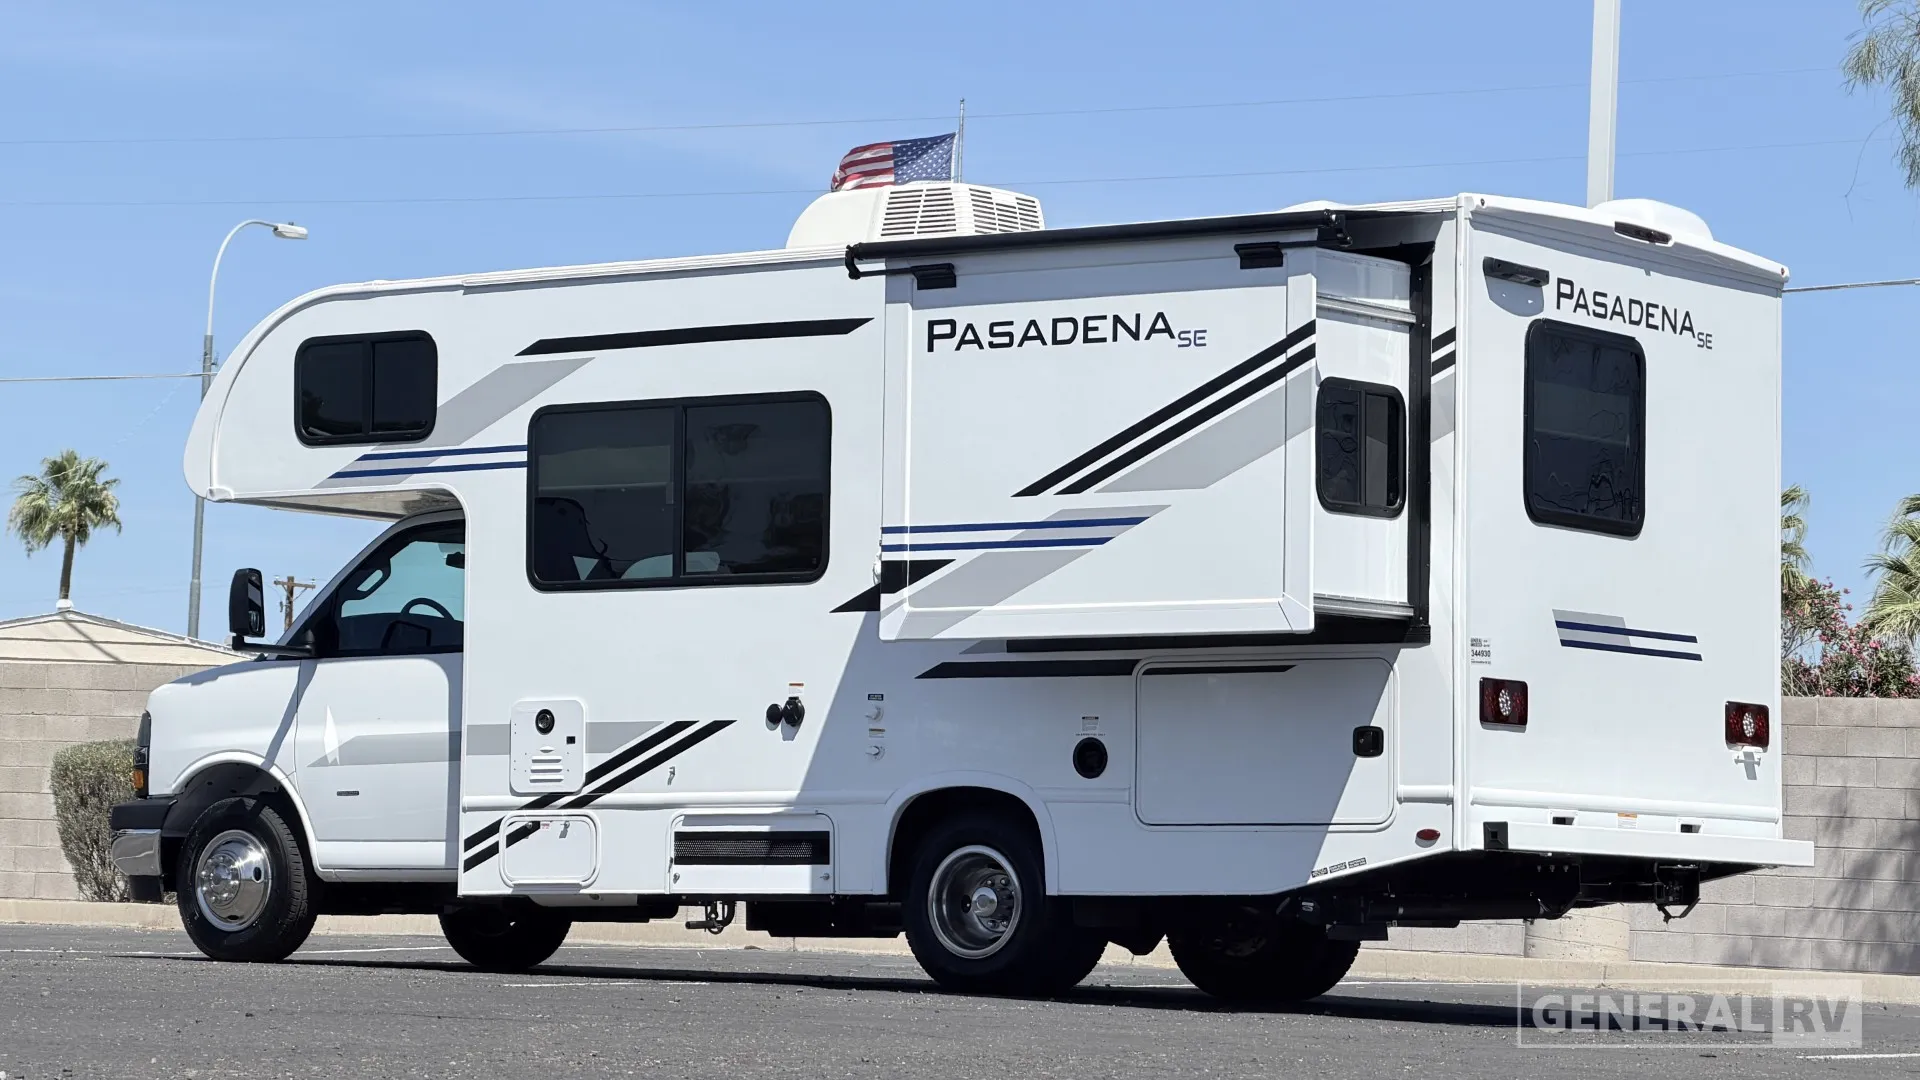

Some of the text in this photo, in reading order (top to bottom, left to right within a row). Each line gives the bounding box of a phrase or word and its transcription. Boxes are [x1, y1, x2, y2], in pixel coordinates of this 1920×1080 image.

[927, 311, 1208, 353] PASADENA SE
[1556, 276, 1713, 350] PASADENA SE
[1471, 649, 1491, 657] 344930
